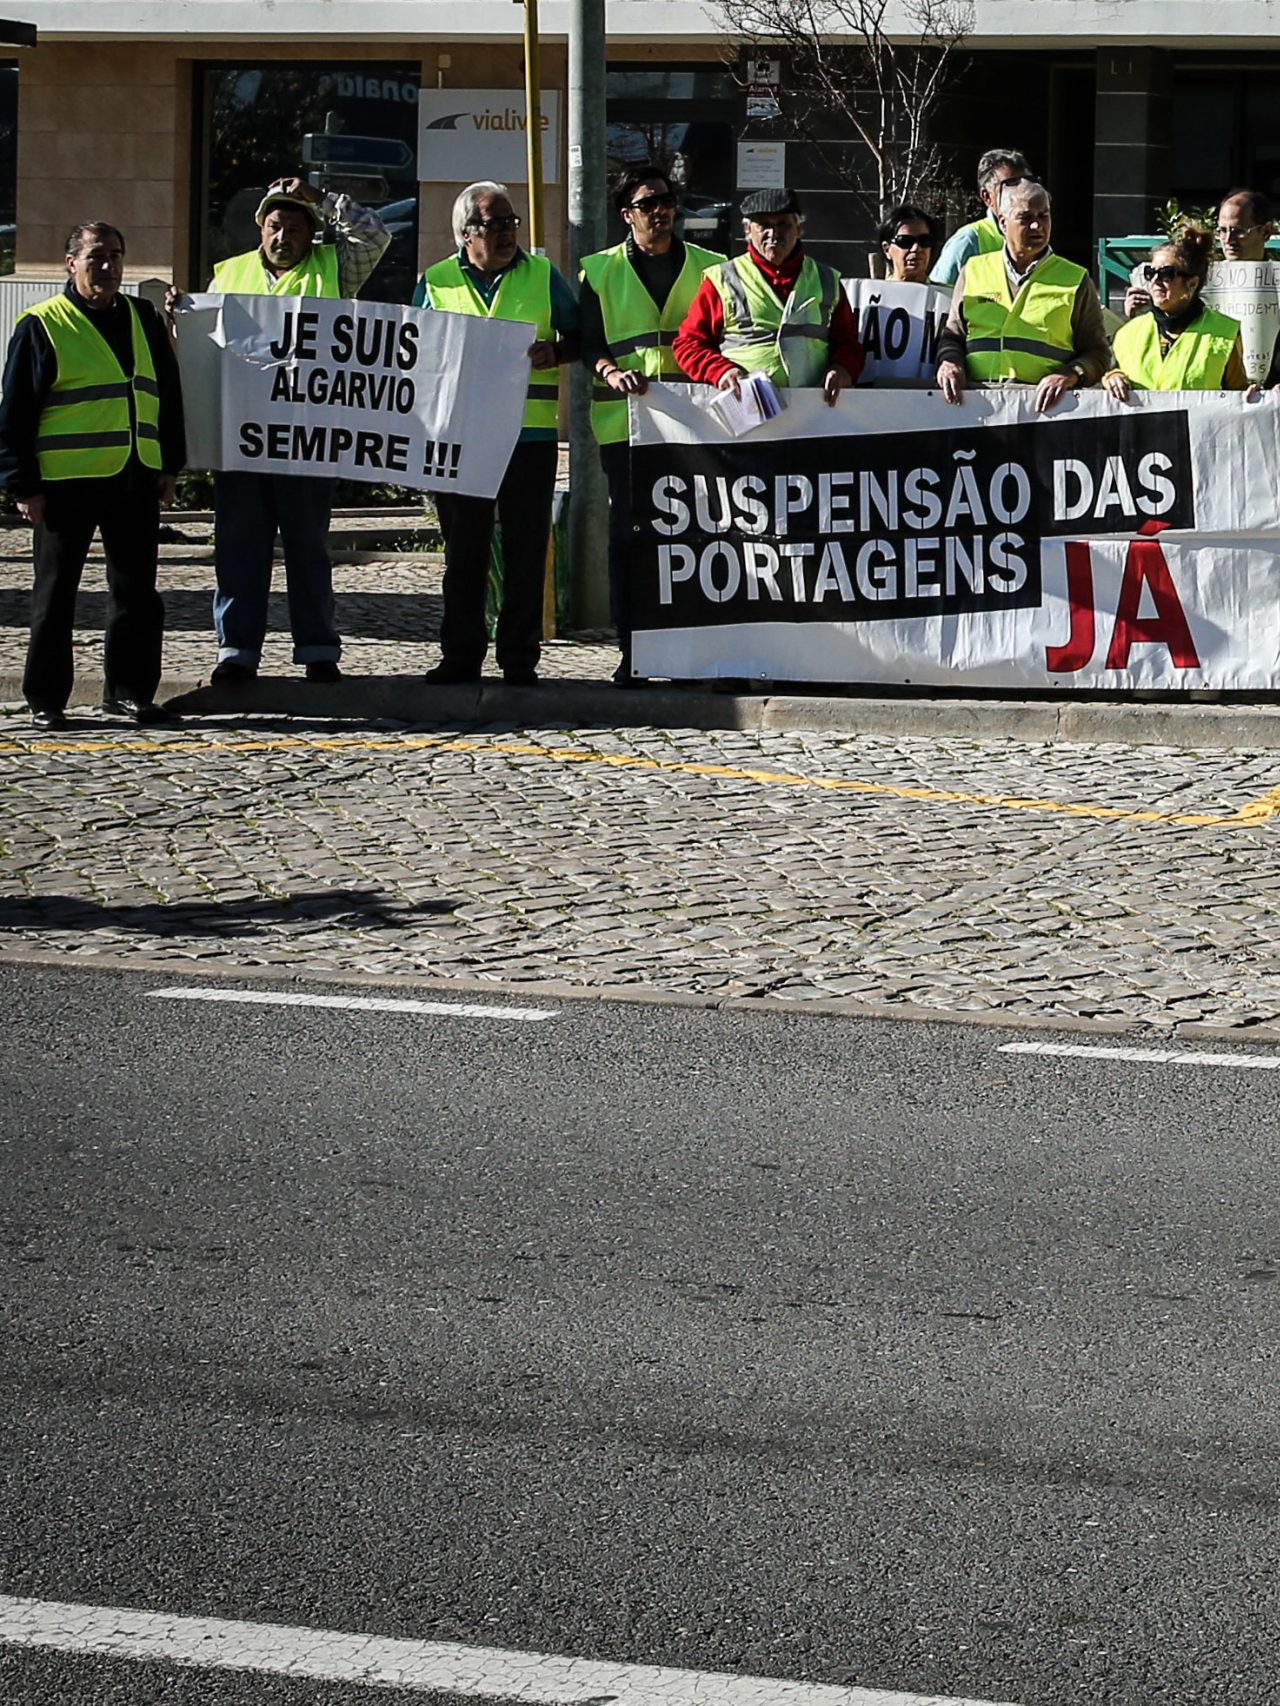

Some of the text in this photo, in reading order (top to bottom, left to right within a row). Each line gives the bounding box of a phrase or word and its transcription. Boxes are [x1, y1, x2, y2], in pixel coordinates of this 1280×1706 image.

[473, 109, 549, 131] vialive
[270, 312, 419, 371] JE SUIS
[270, 366, 415, 415] ALGARVIO
[239, 422, 462, 479] SEMPRE !!!
[651, 449, 1177, 536] SUSPENSÃO DAS
[657, 531, 1028, 604] PORTAGENS
[1045, 519, 1201, 672] JÁ
